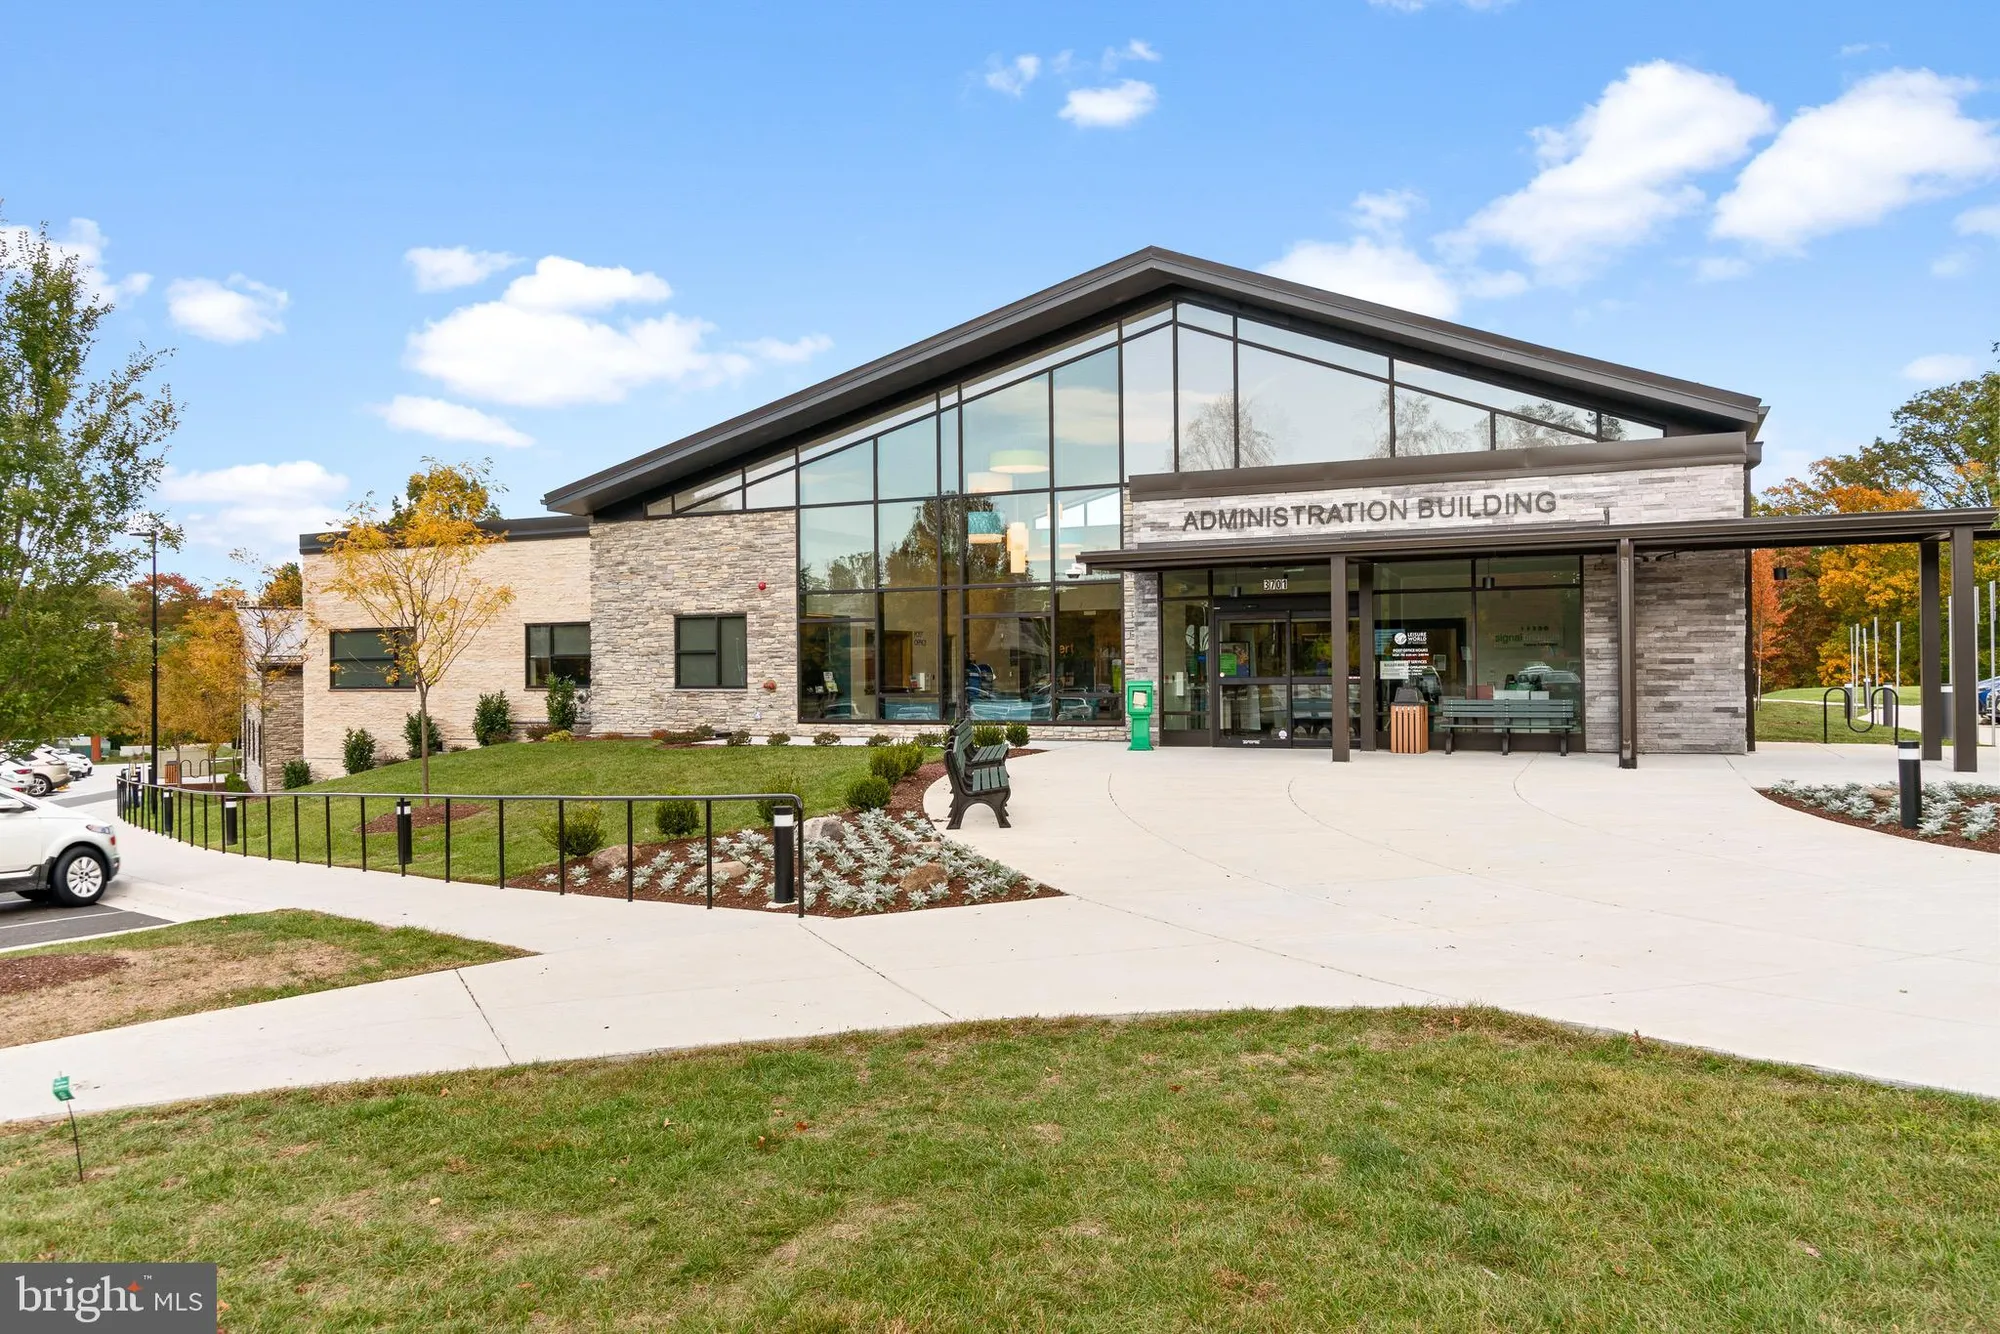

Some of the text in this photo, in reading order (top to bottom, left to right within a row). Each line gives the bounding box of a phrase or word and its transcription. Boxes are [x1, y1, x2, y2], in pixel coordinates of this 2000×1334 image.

[1183, 491, 1556, 531] ADMINISTRATION BUILDING
[1263, 578, 1288, 590] 3701
